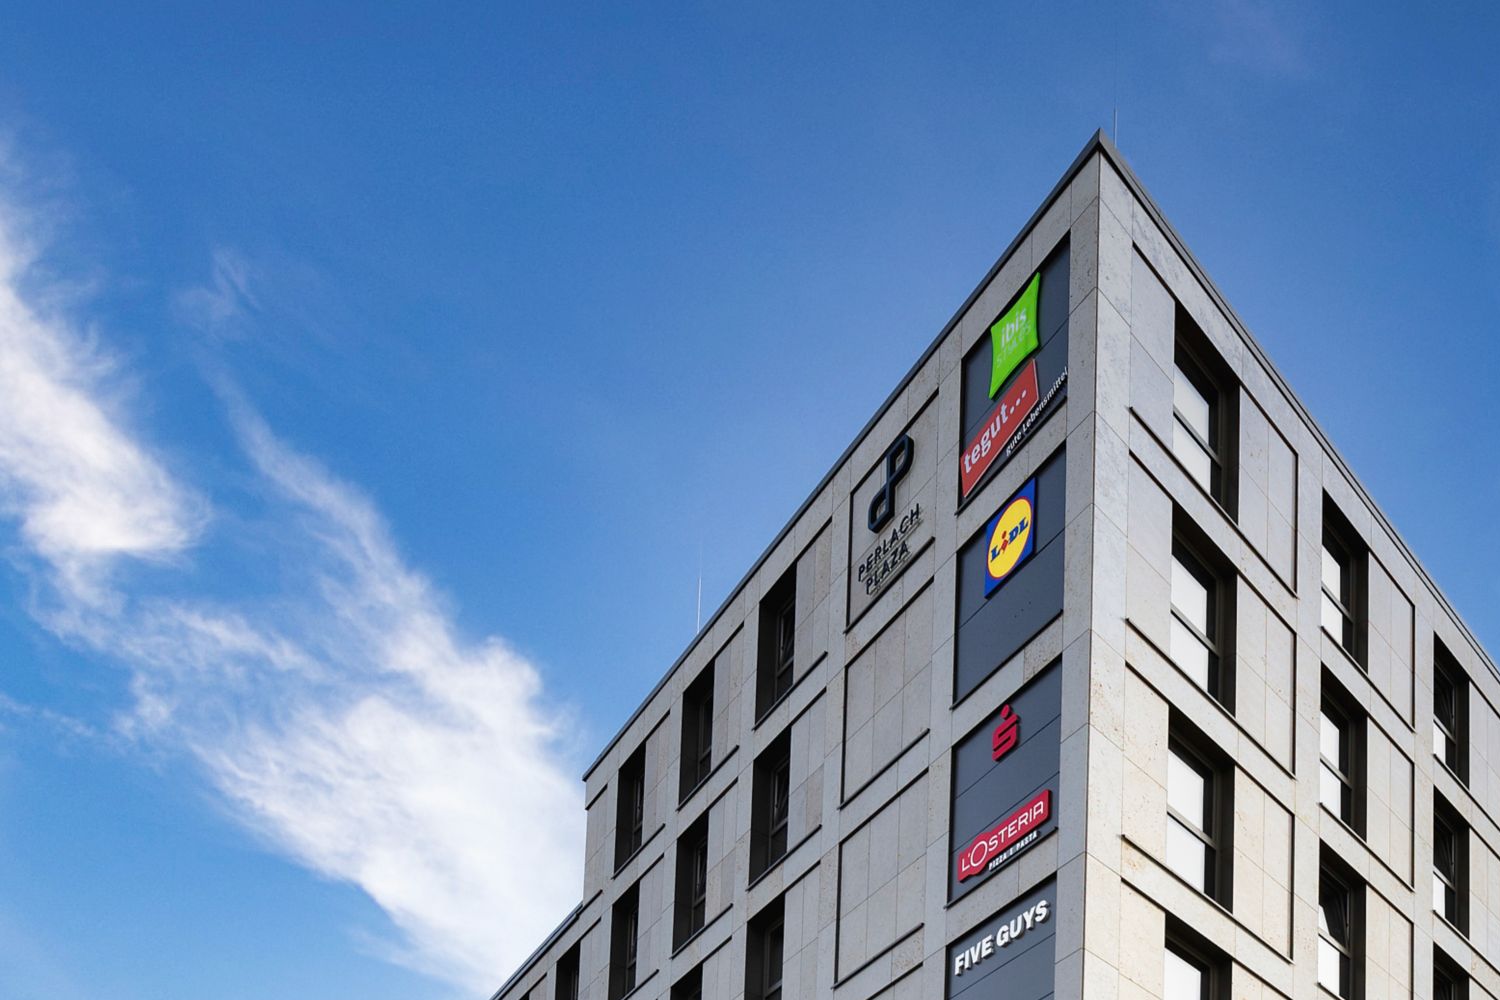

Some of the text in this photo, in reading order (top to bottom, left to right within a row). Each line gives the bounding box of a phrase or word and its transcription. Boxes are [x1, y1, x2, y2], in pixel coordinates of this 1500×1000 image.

[1001, 308, 1027, 345] ibis
[1006, 365, 1068, 458] gute Lebensmittel
[858, 503, 921, 582] PERLACH
[866, 540, 909, 595] PLAZA
[961, 800, 1044, 872] L'OSTERIA
[988, 854, 1008, 872] PIZZA
[1016, 831, 1039, 851] PASTA
[954, 900, 1049, 976] FIVE GUYS
